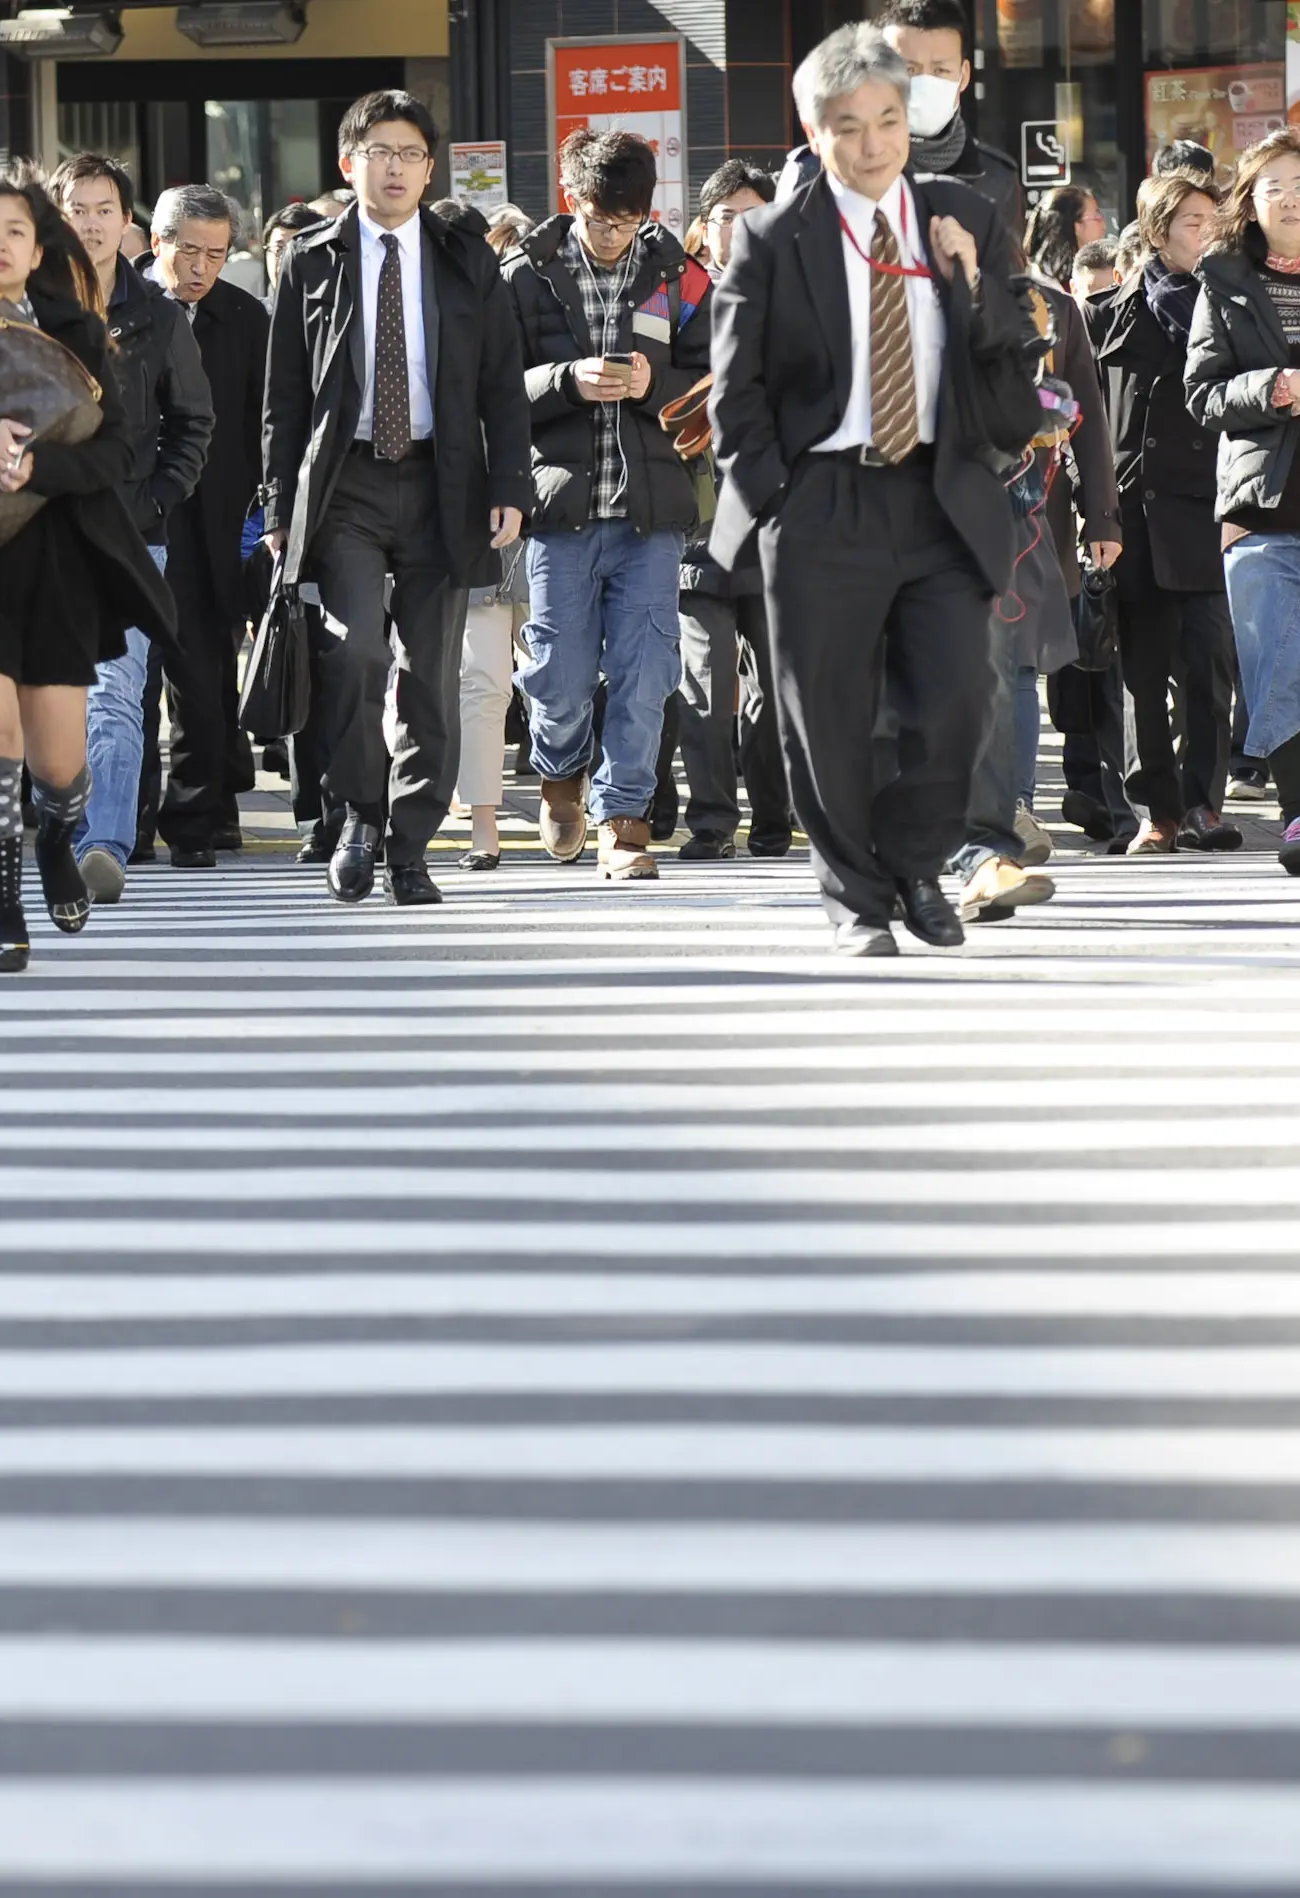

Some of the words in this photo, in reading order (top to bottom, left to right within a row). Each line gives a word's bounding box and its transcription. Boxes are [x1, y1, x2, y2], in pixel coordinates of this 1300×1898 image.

[568, 64, 668, 97] 客席ご案内
